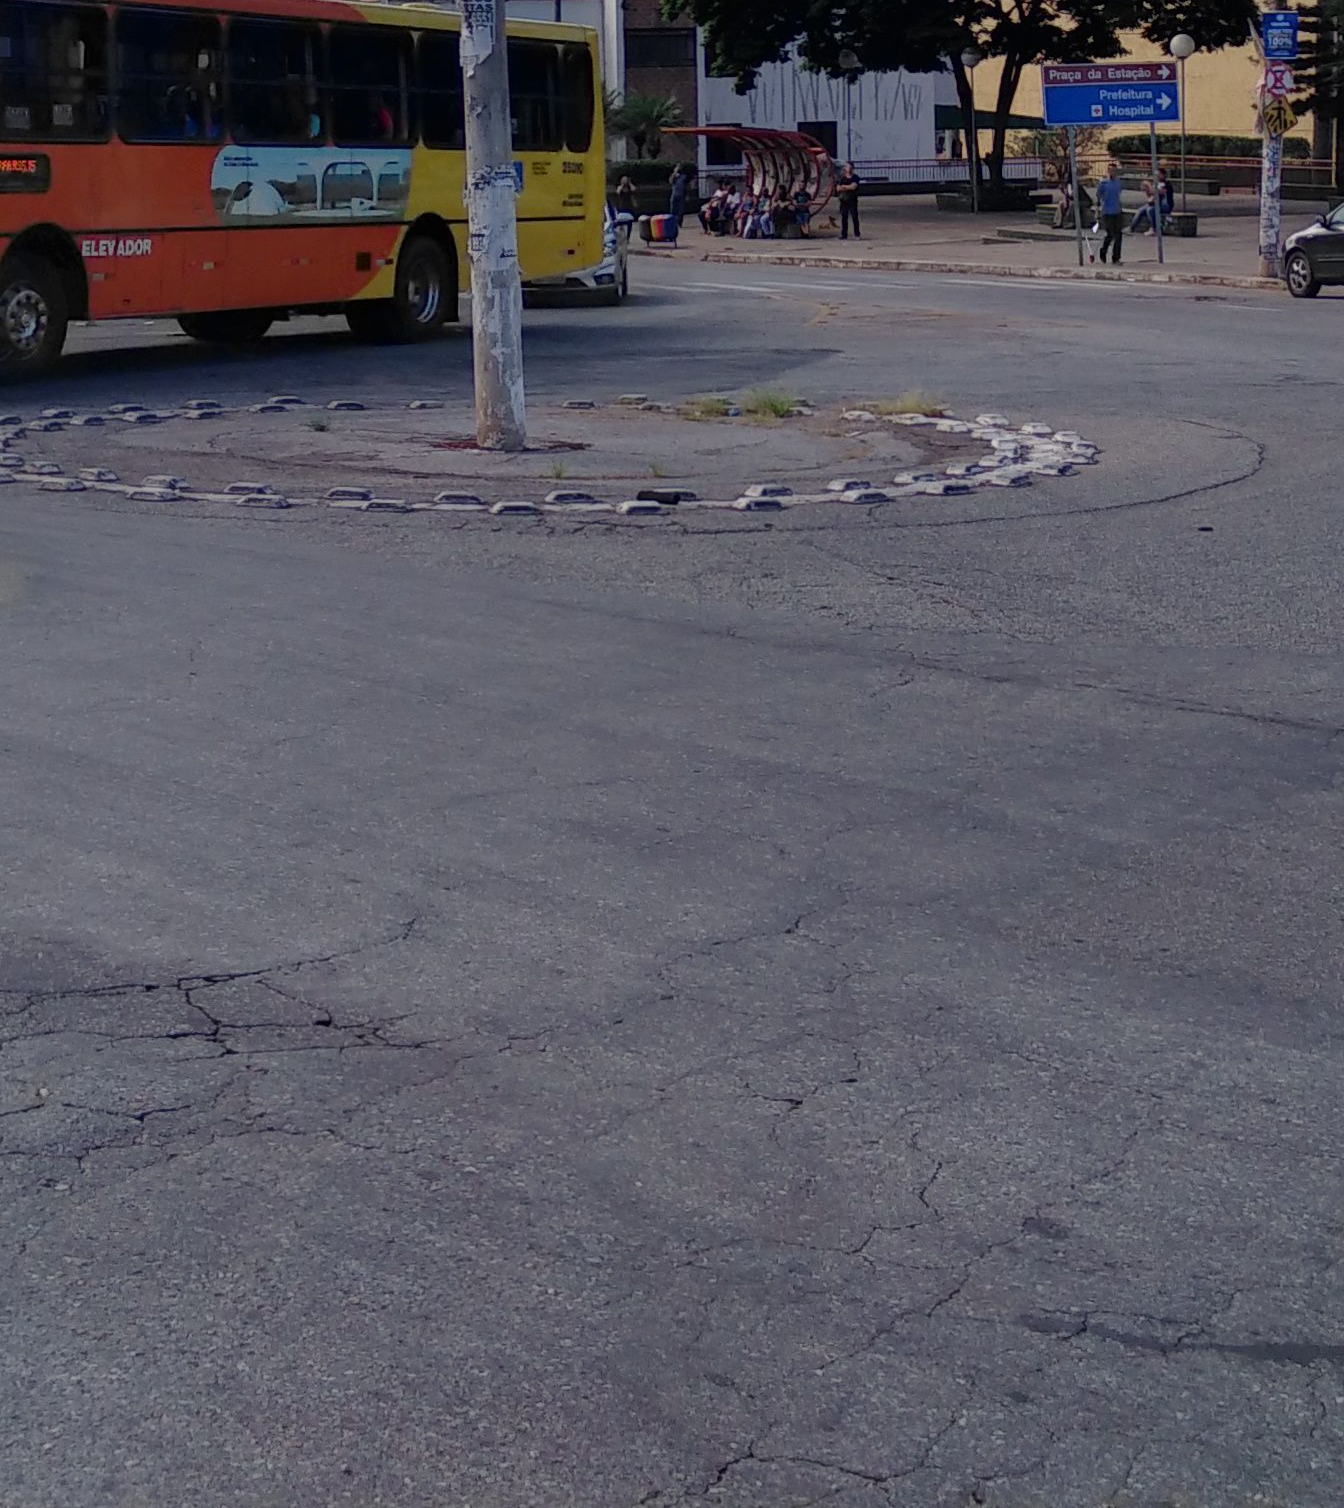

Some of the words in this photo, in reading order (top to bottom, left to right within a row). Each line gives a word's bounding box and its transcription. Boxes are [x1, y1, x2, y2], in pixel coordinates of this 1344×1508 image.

[1049, 69, 1081, 82] Praça
[1088, 69, 1101, 79] da
[1108, 67, 1152, 80] Estação
[1099, 89, 1153, 100] Prefeitura
[1109, 105, 1154, 118] Hospital
[82, 239, 152, 256] ELEVADOR
